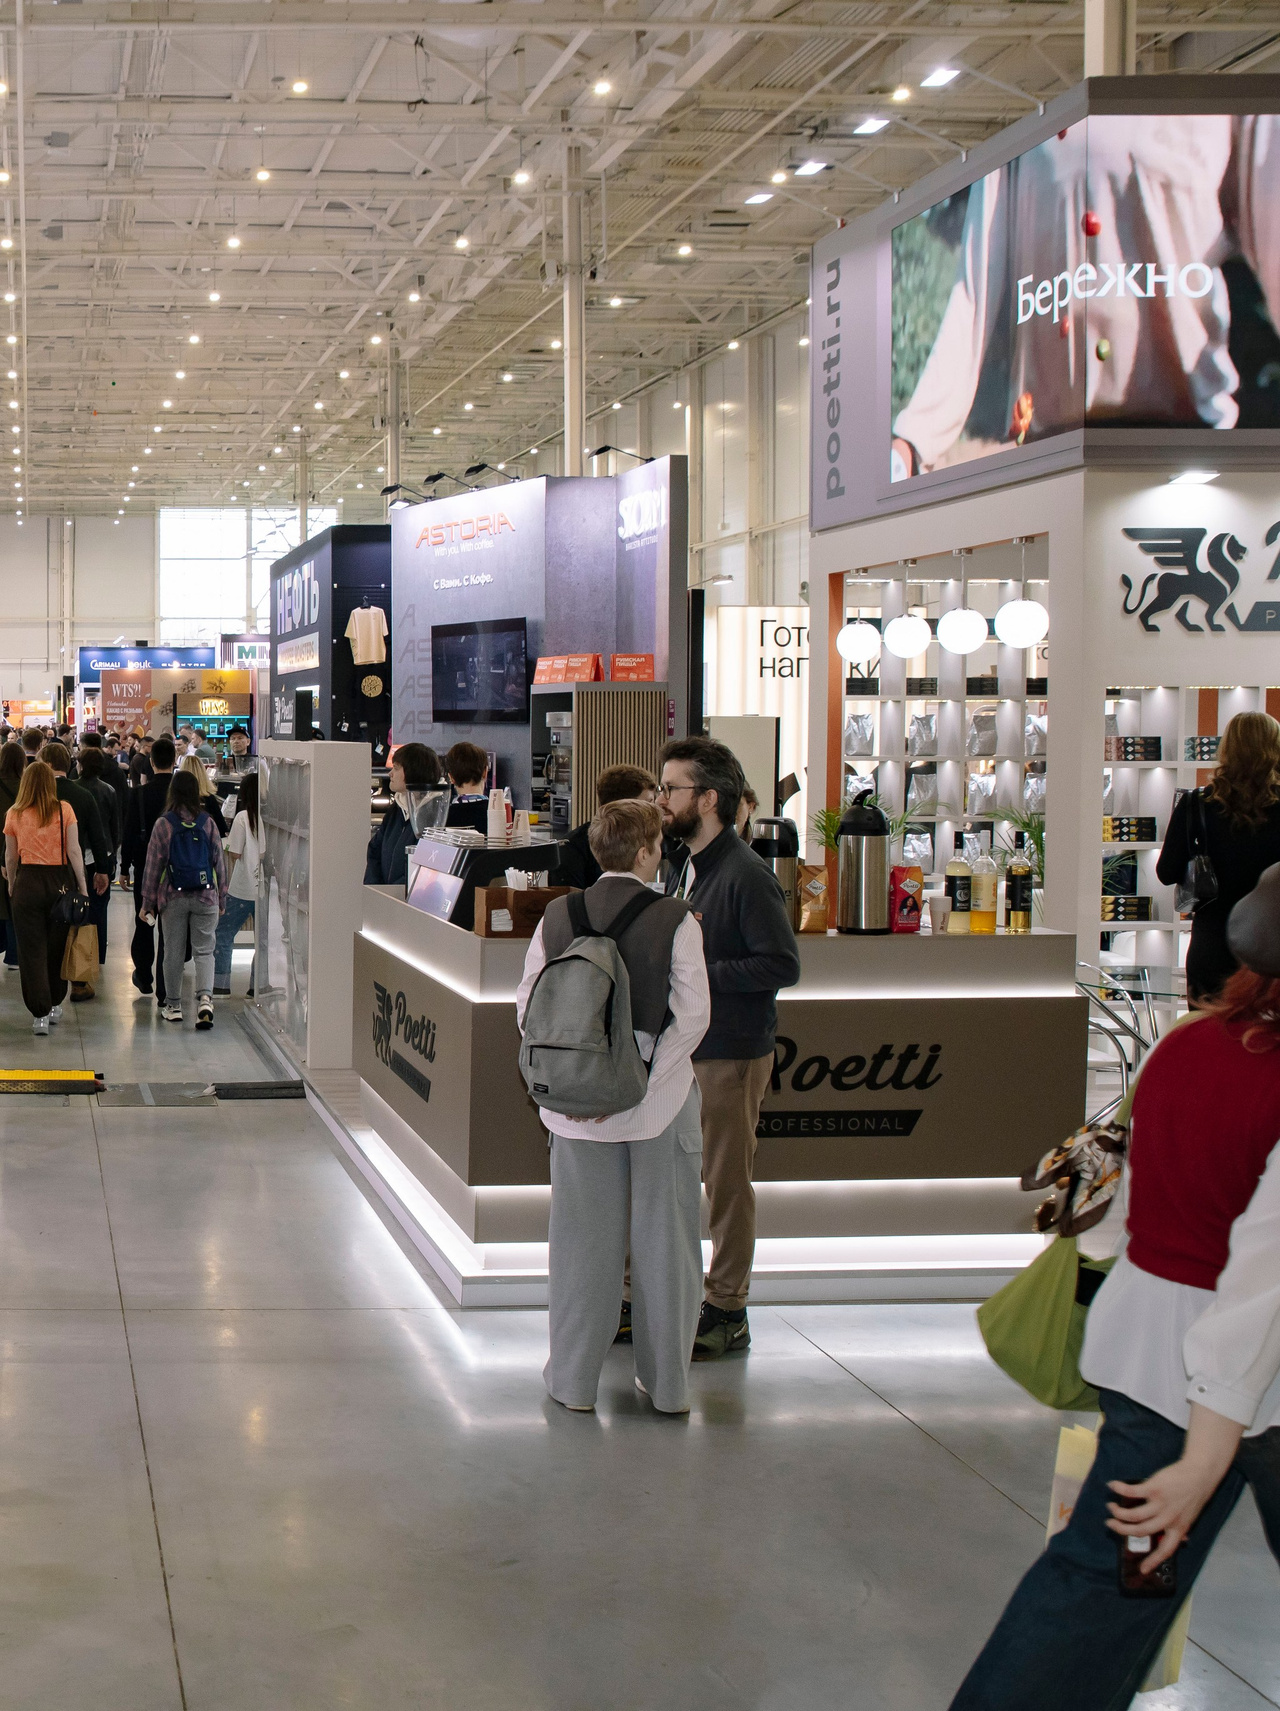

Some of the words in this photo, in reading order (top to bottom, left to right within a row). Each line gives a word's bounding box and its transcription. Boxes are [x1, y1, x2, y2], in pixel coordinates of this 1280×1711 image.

[1016, 261, 1215, 325] Бережно
[822, 256, 844, 501] poetti.ru
[415, 512, 516, 549] ASTORIA
[434, 545, 448, 558] With
[460, 541, 473, 553] With
[474, 538, 494, 551] coffee.
[276, 560, 320, 636] НЕФТЬ
[440, 577, 462, 590] Вами.
[471, 572, 493, 586] Кофе.
[90, 659, 120, 670] CARIMALI
[111, 683, 142, 698] WTS?!
[395, 991, 437, 1064] Poetti
[771, 1036, 944, 1094] Poetti
[757, 1117, 904, 1131] ROFESSIONAL
